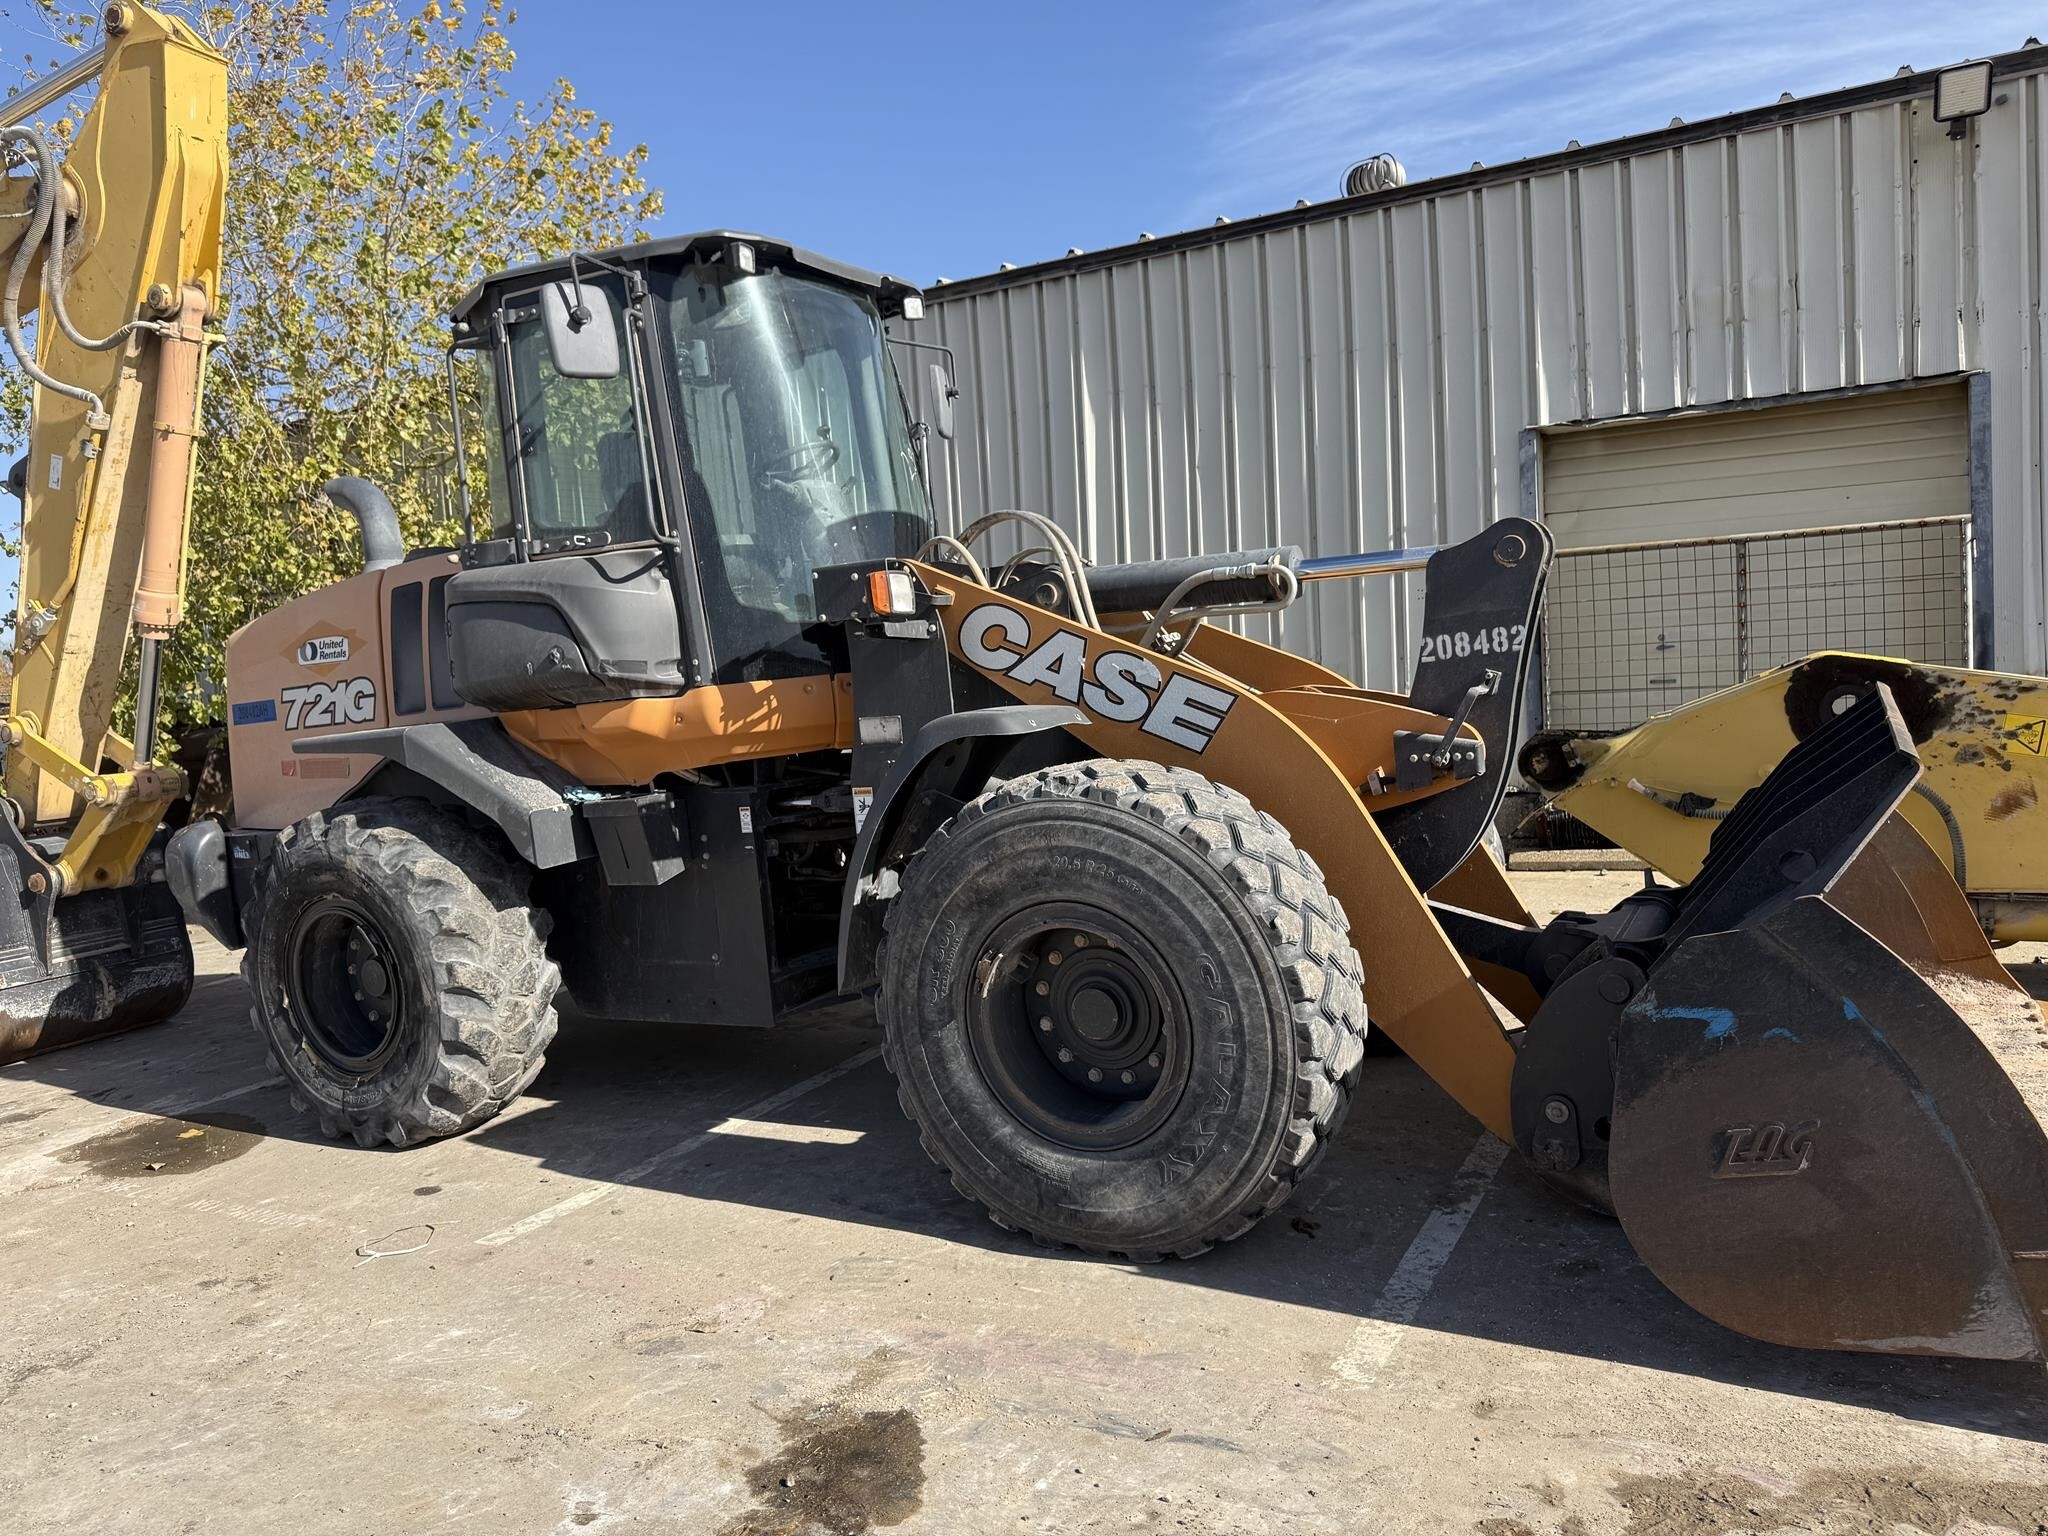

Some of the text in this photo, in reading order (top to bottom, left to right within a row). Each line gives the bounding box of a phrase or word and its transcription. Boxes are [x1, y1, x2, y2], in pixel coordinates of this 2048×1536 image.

[319, 638, 344, 651] United
[319, 648, 347, 661] Rentals
[1420, 624, 1526, 664] 208482
[959, 602, 1238, 755] CASE
[280, 676, 377, 732] 721G
[1158, 951, 1238, 1187] GALAXY
